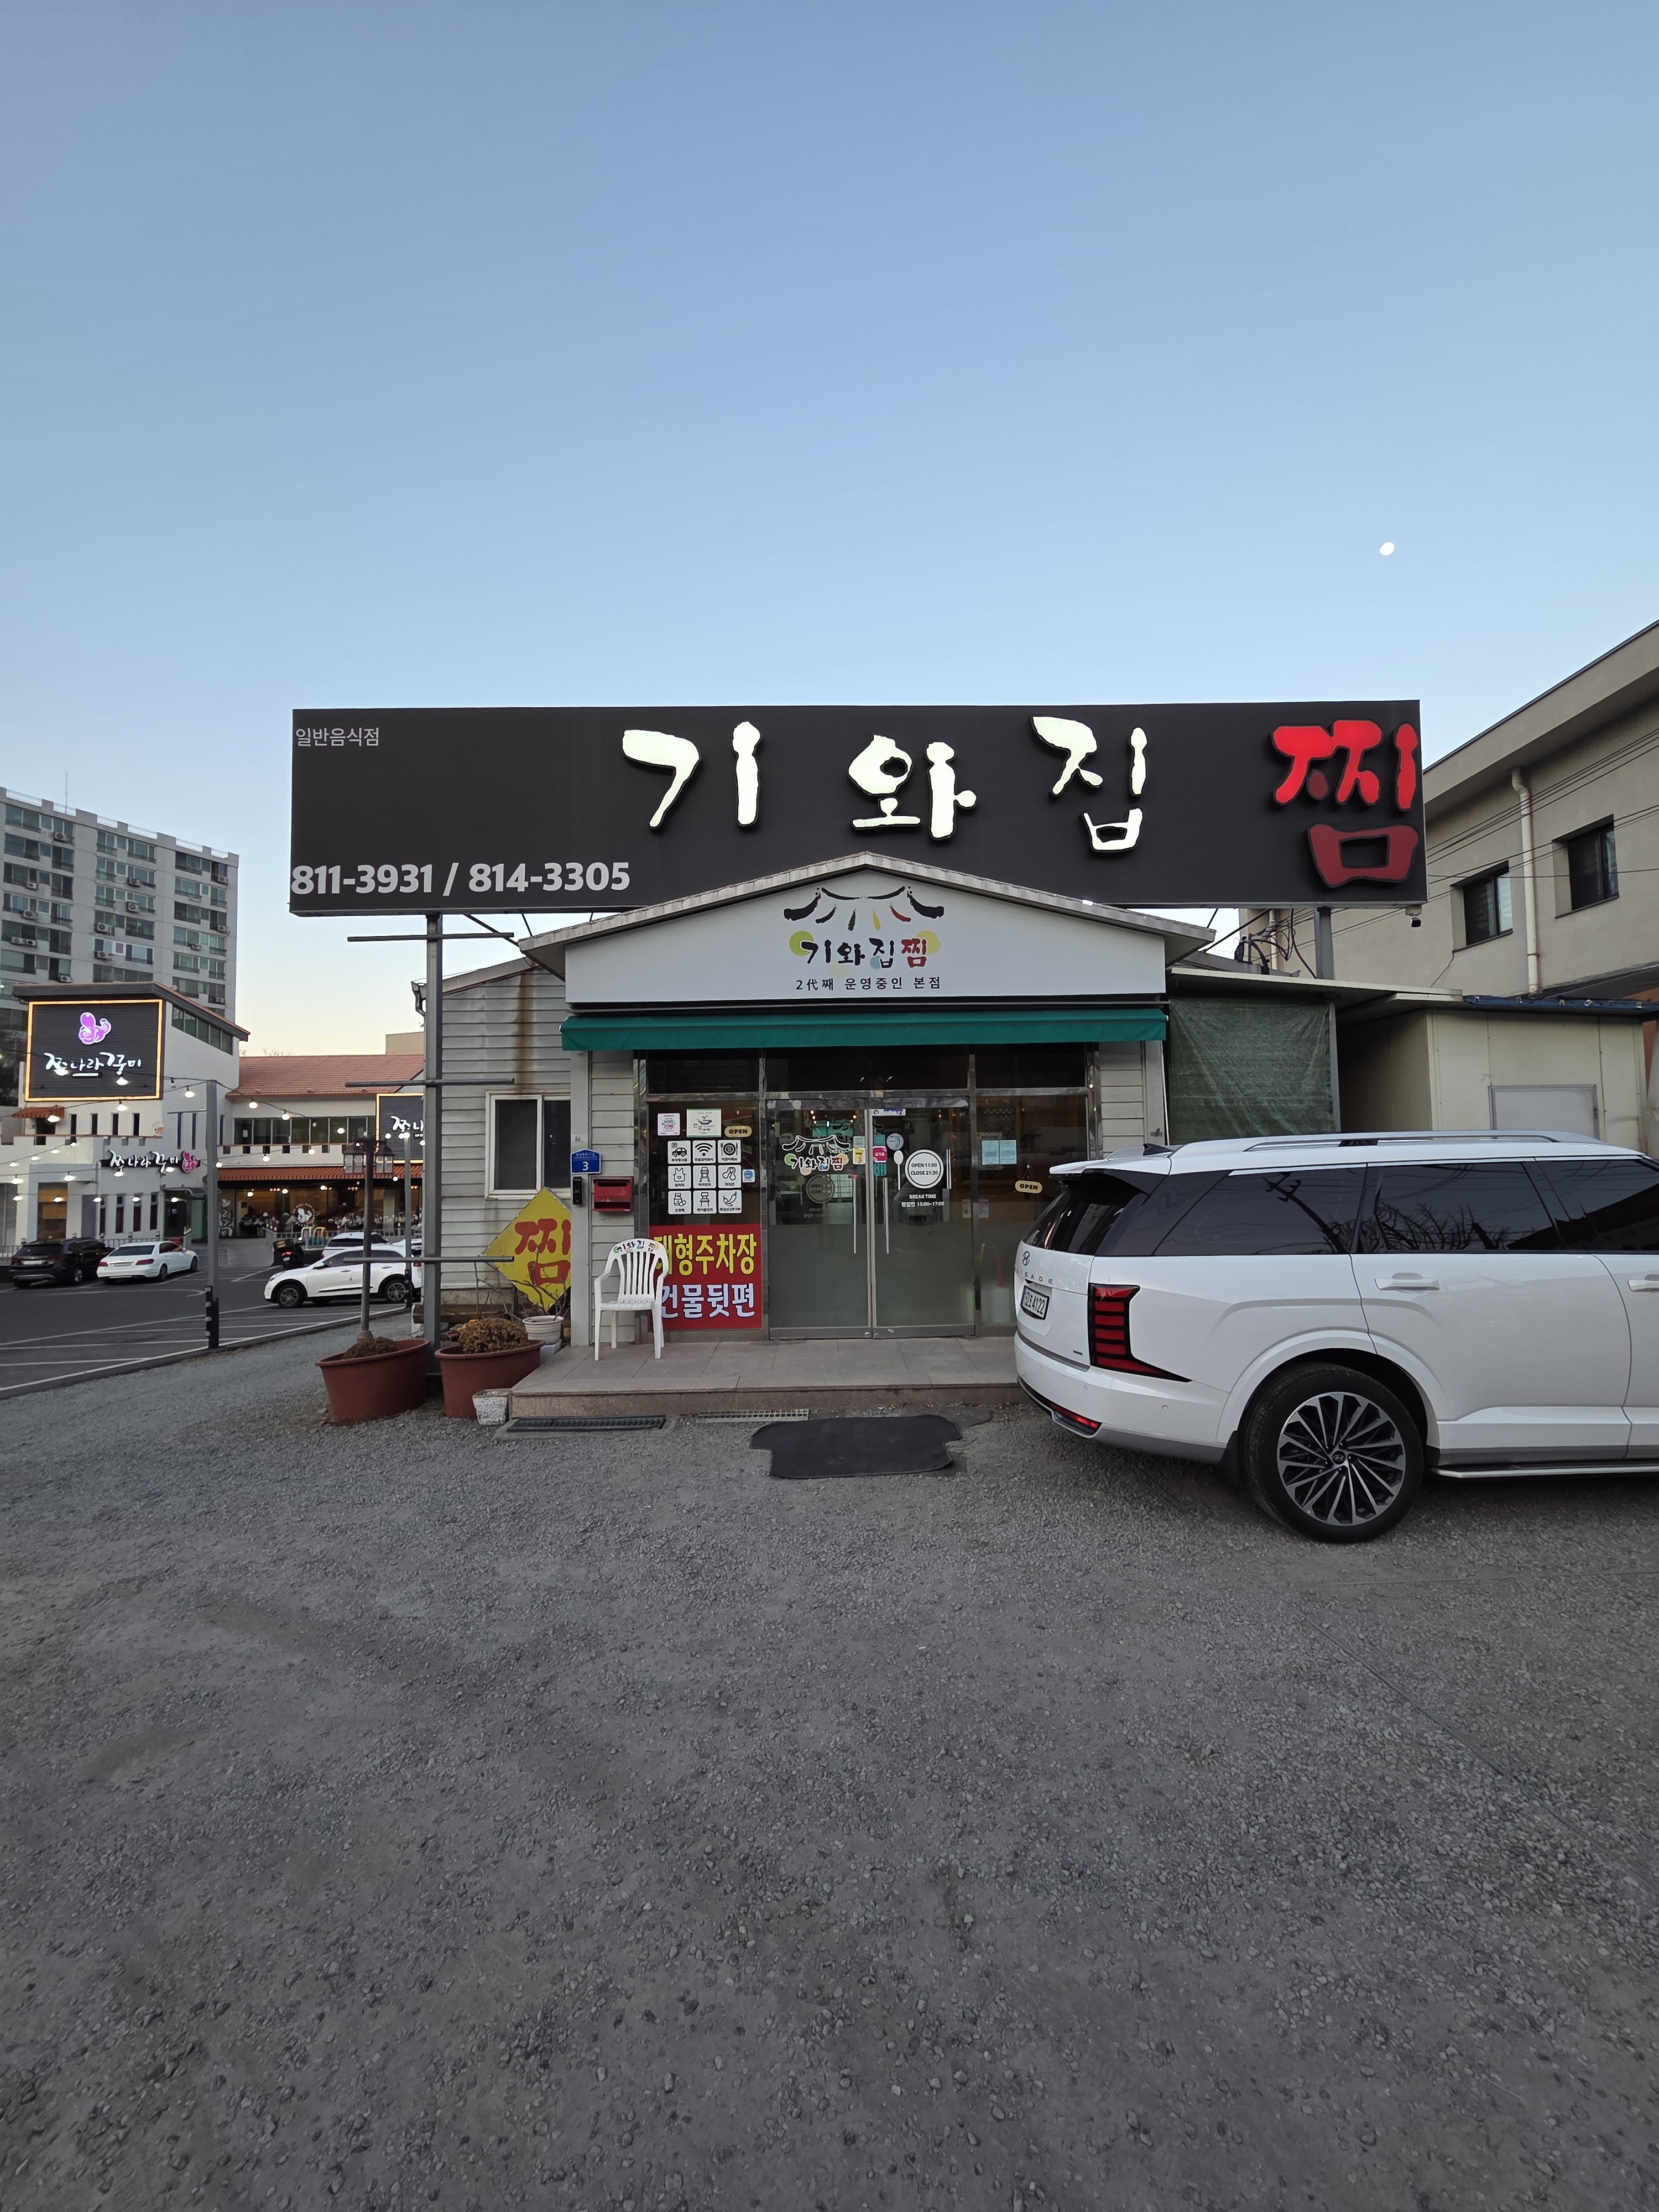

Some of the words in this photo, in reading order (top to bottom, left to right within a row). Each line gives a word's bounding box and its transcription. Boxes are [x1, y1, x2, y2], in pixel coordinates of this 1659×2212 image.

[296, 728, 379, 747] 일반음식점
[291, 865, 432, 895] 811-3931
[469, 862, 630, 893] 814-3305
[801, 938, 927, 968] 기와집찜
[796, 978, 834, 992] 2代째
[844, 977, 902, 990] 운영중인
[914, 976, 941, 989] 본점
[582, 1161, 589, 1171] 3
[514, 1218, 571, 1286] 찜
[654, 1233, 757, 1276] 대형주차장
[661, 1282, 755, 1318] 건물뒷편
